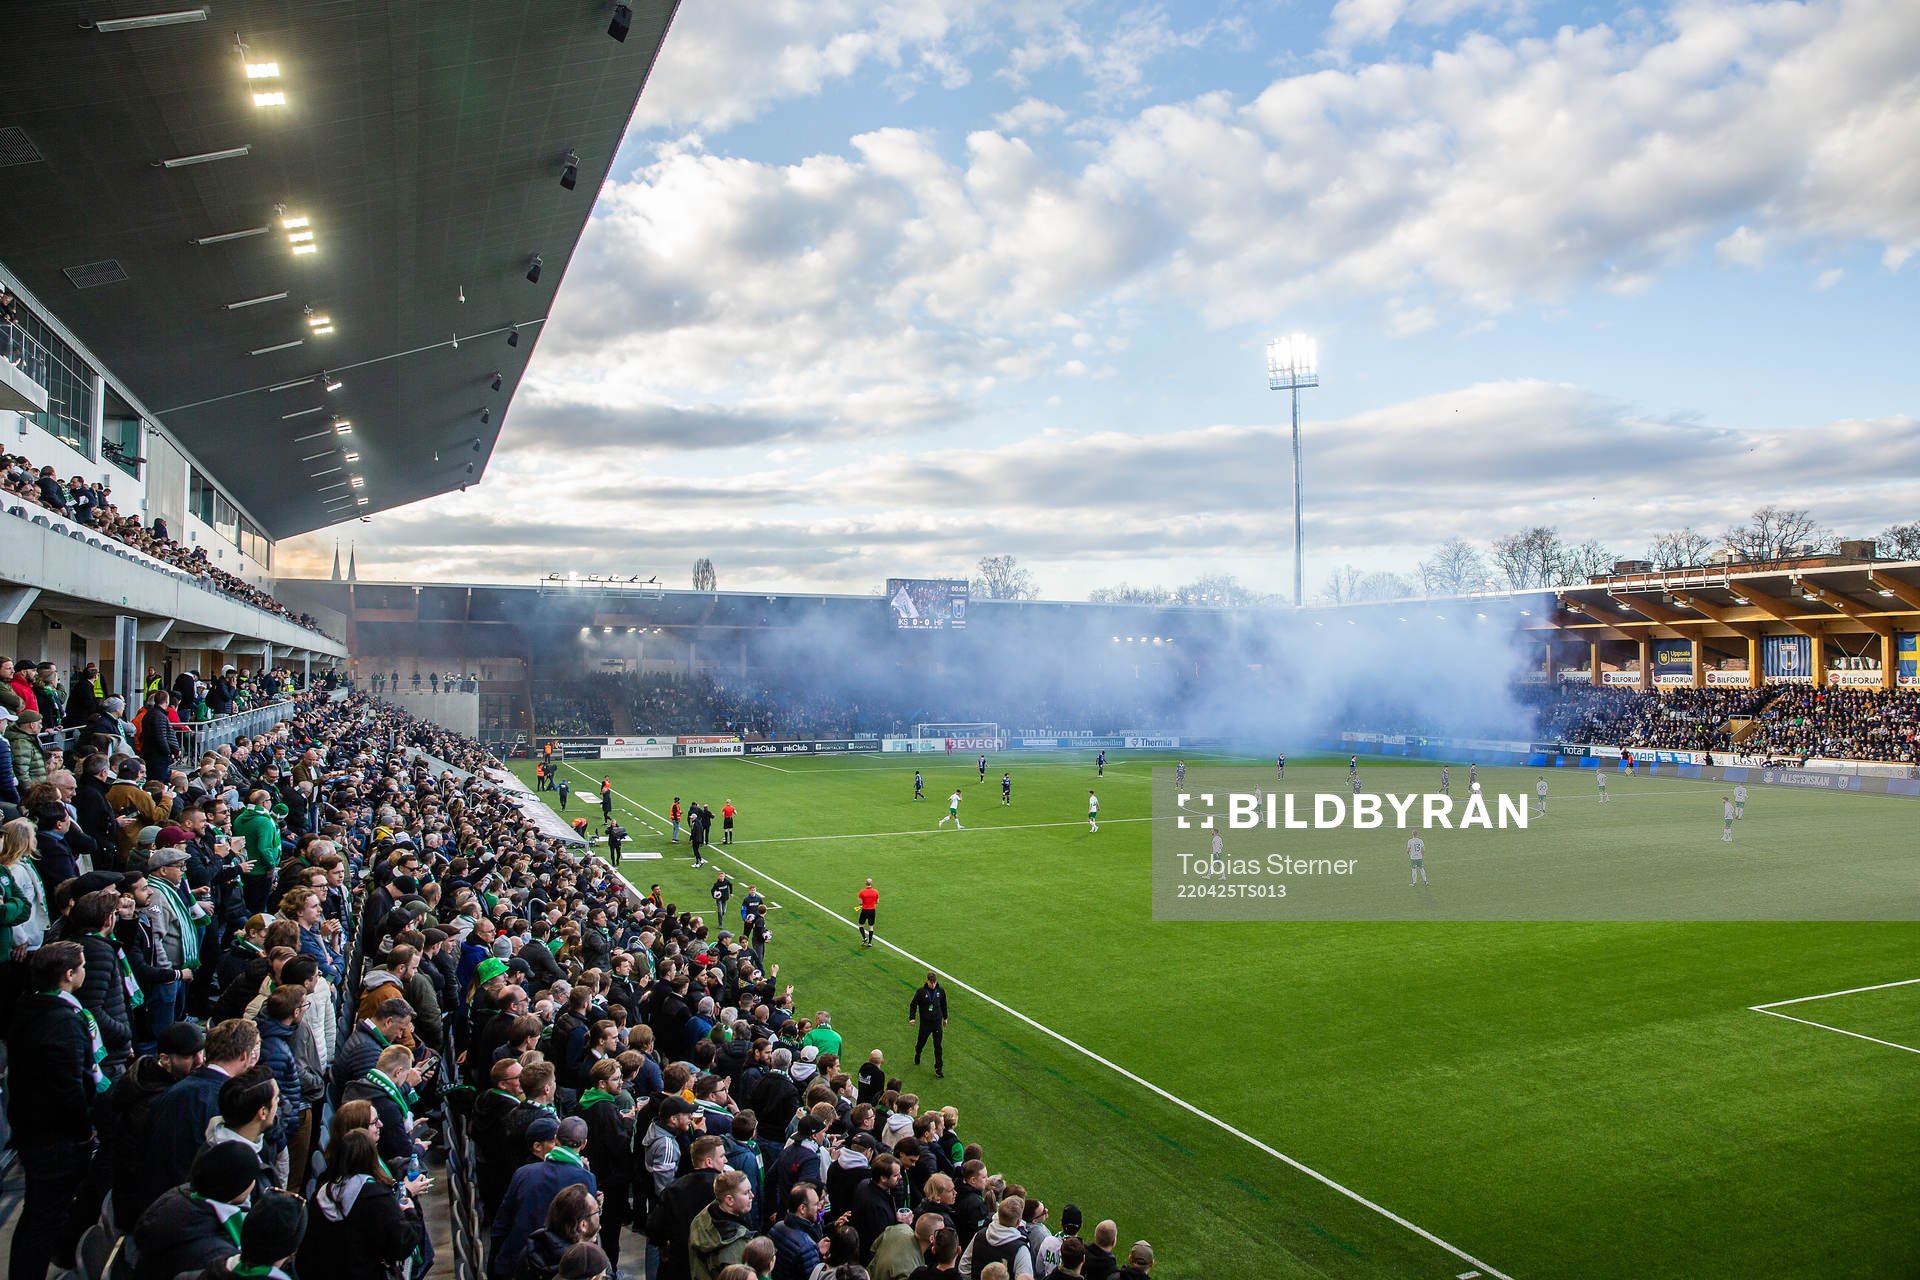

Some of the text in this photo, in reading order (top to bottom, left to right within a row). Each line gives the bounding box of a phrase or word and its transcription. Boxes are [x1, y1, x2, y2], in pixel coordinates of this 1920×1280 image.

[1670, 650, 1691, 658] Uppsala
[1141, 737, 1172, 747] Thermia
[698, 745, 732, 754] Ventilation
[782, 744, 808, 752] inkClub
[1563, 746, 1586, 755] notar
[1630, 751, 1655, 761] MAR
[1780, 773, 1830, 787] ALLSVENSKAN
[1414, 843, 1421, 852] 13
